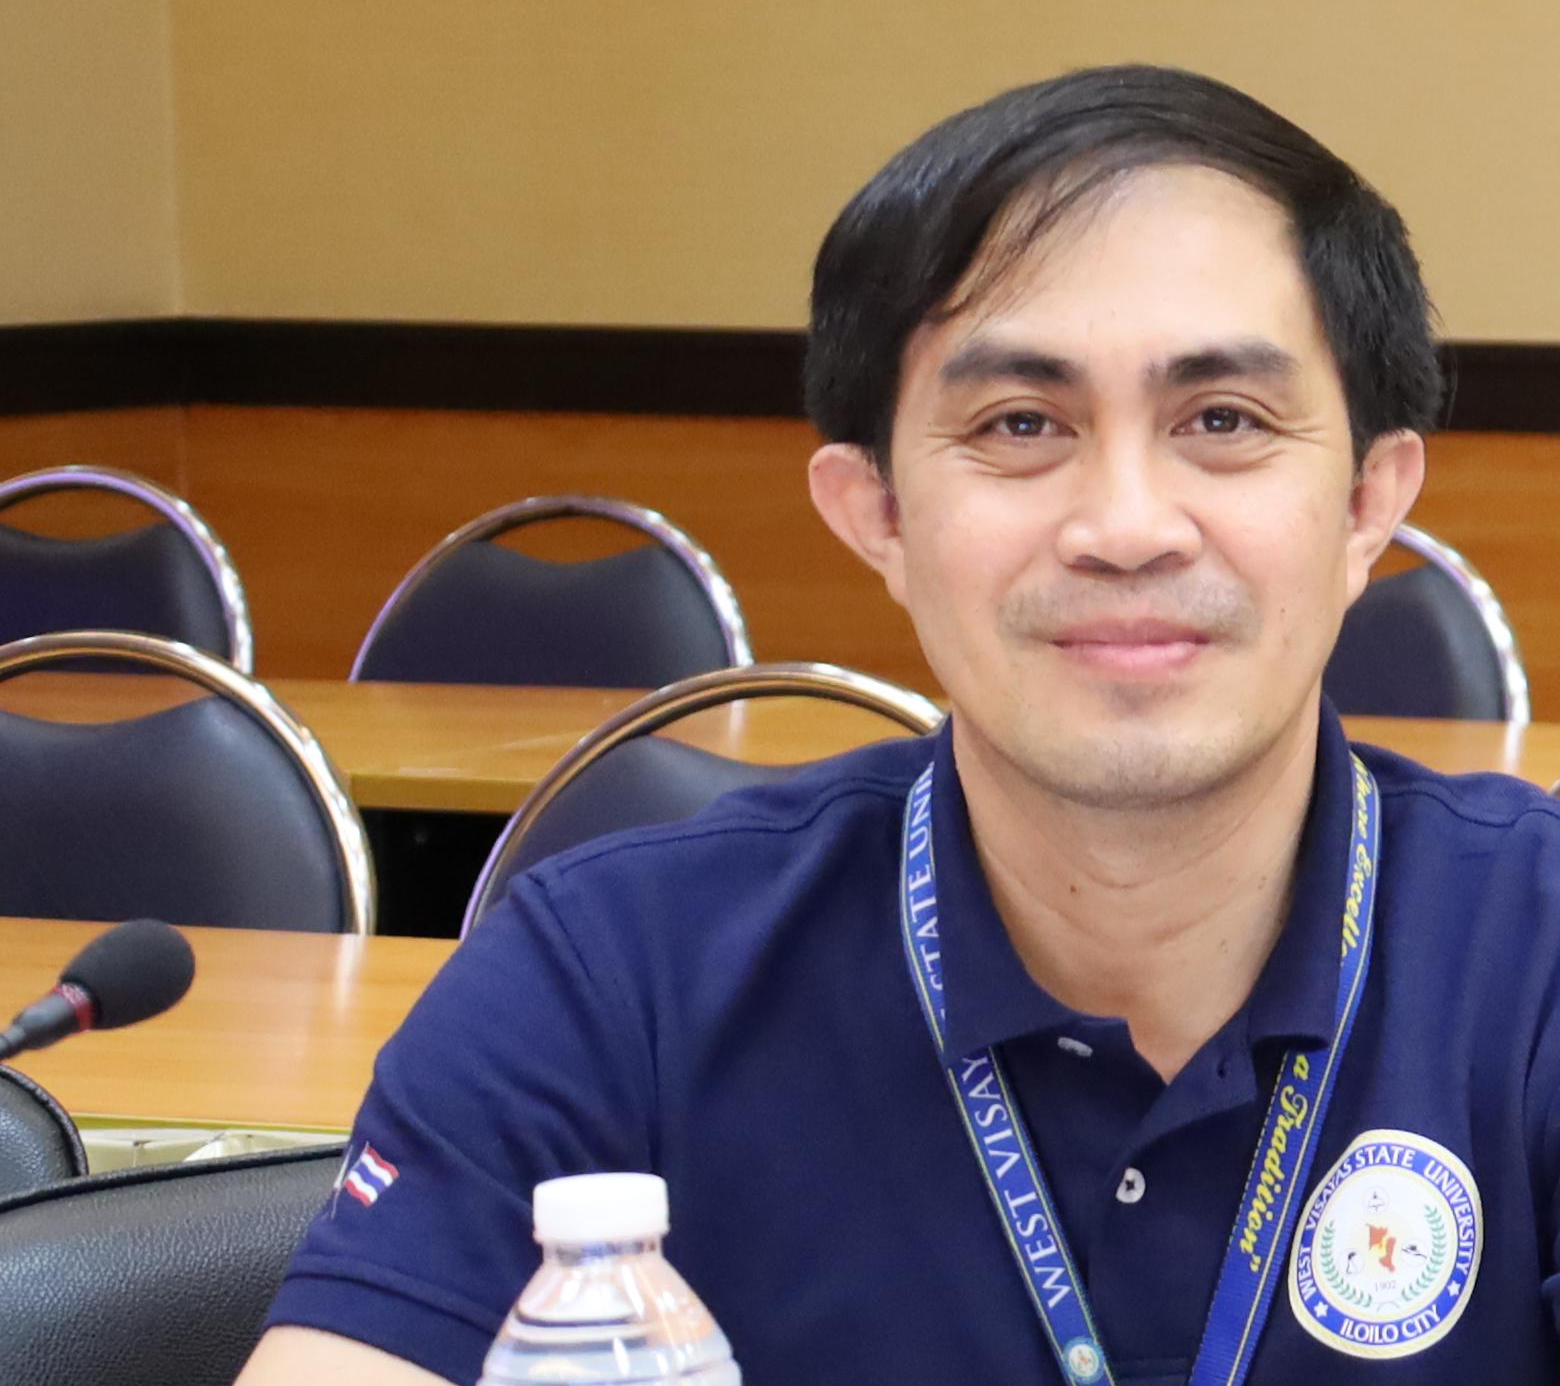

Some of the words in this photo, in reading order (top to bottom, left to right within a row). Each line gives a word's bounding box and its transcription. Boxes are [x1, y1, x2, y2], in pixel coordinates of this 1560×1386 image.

[1293, 1054, 1309, 1080] a
[1355, 1145, 1415, 1168] STATE
[1306, 1161, 1353, 1229] VISAYAS
[1424, 1160, 1475, 1274] UNIVERSITY
[1004, 1190, 1071, 1308] WEST
[1298, 1246, 1316, 1300] WEST
[1340, 1318, 1399, 1342] ILOILO
[1402, 1305, 1441, 1338] CITY
